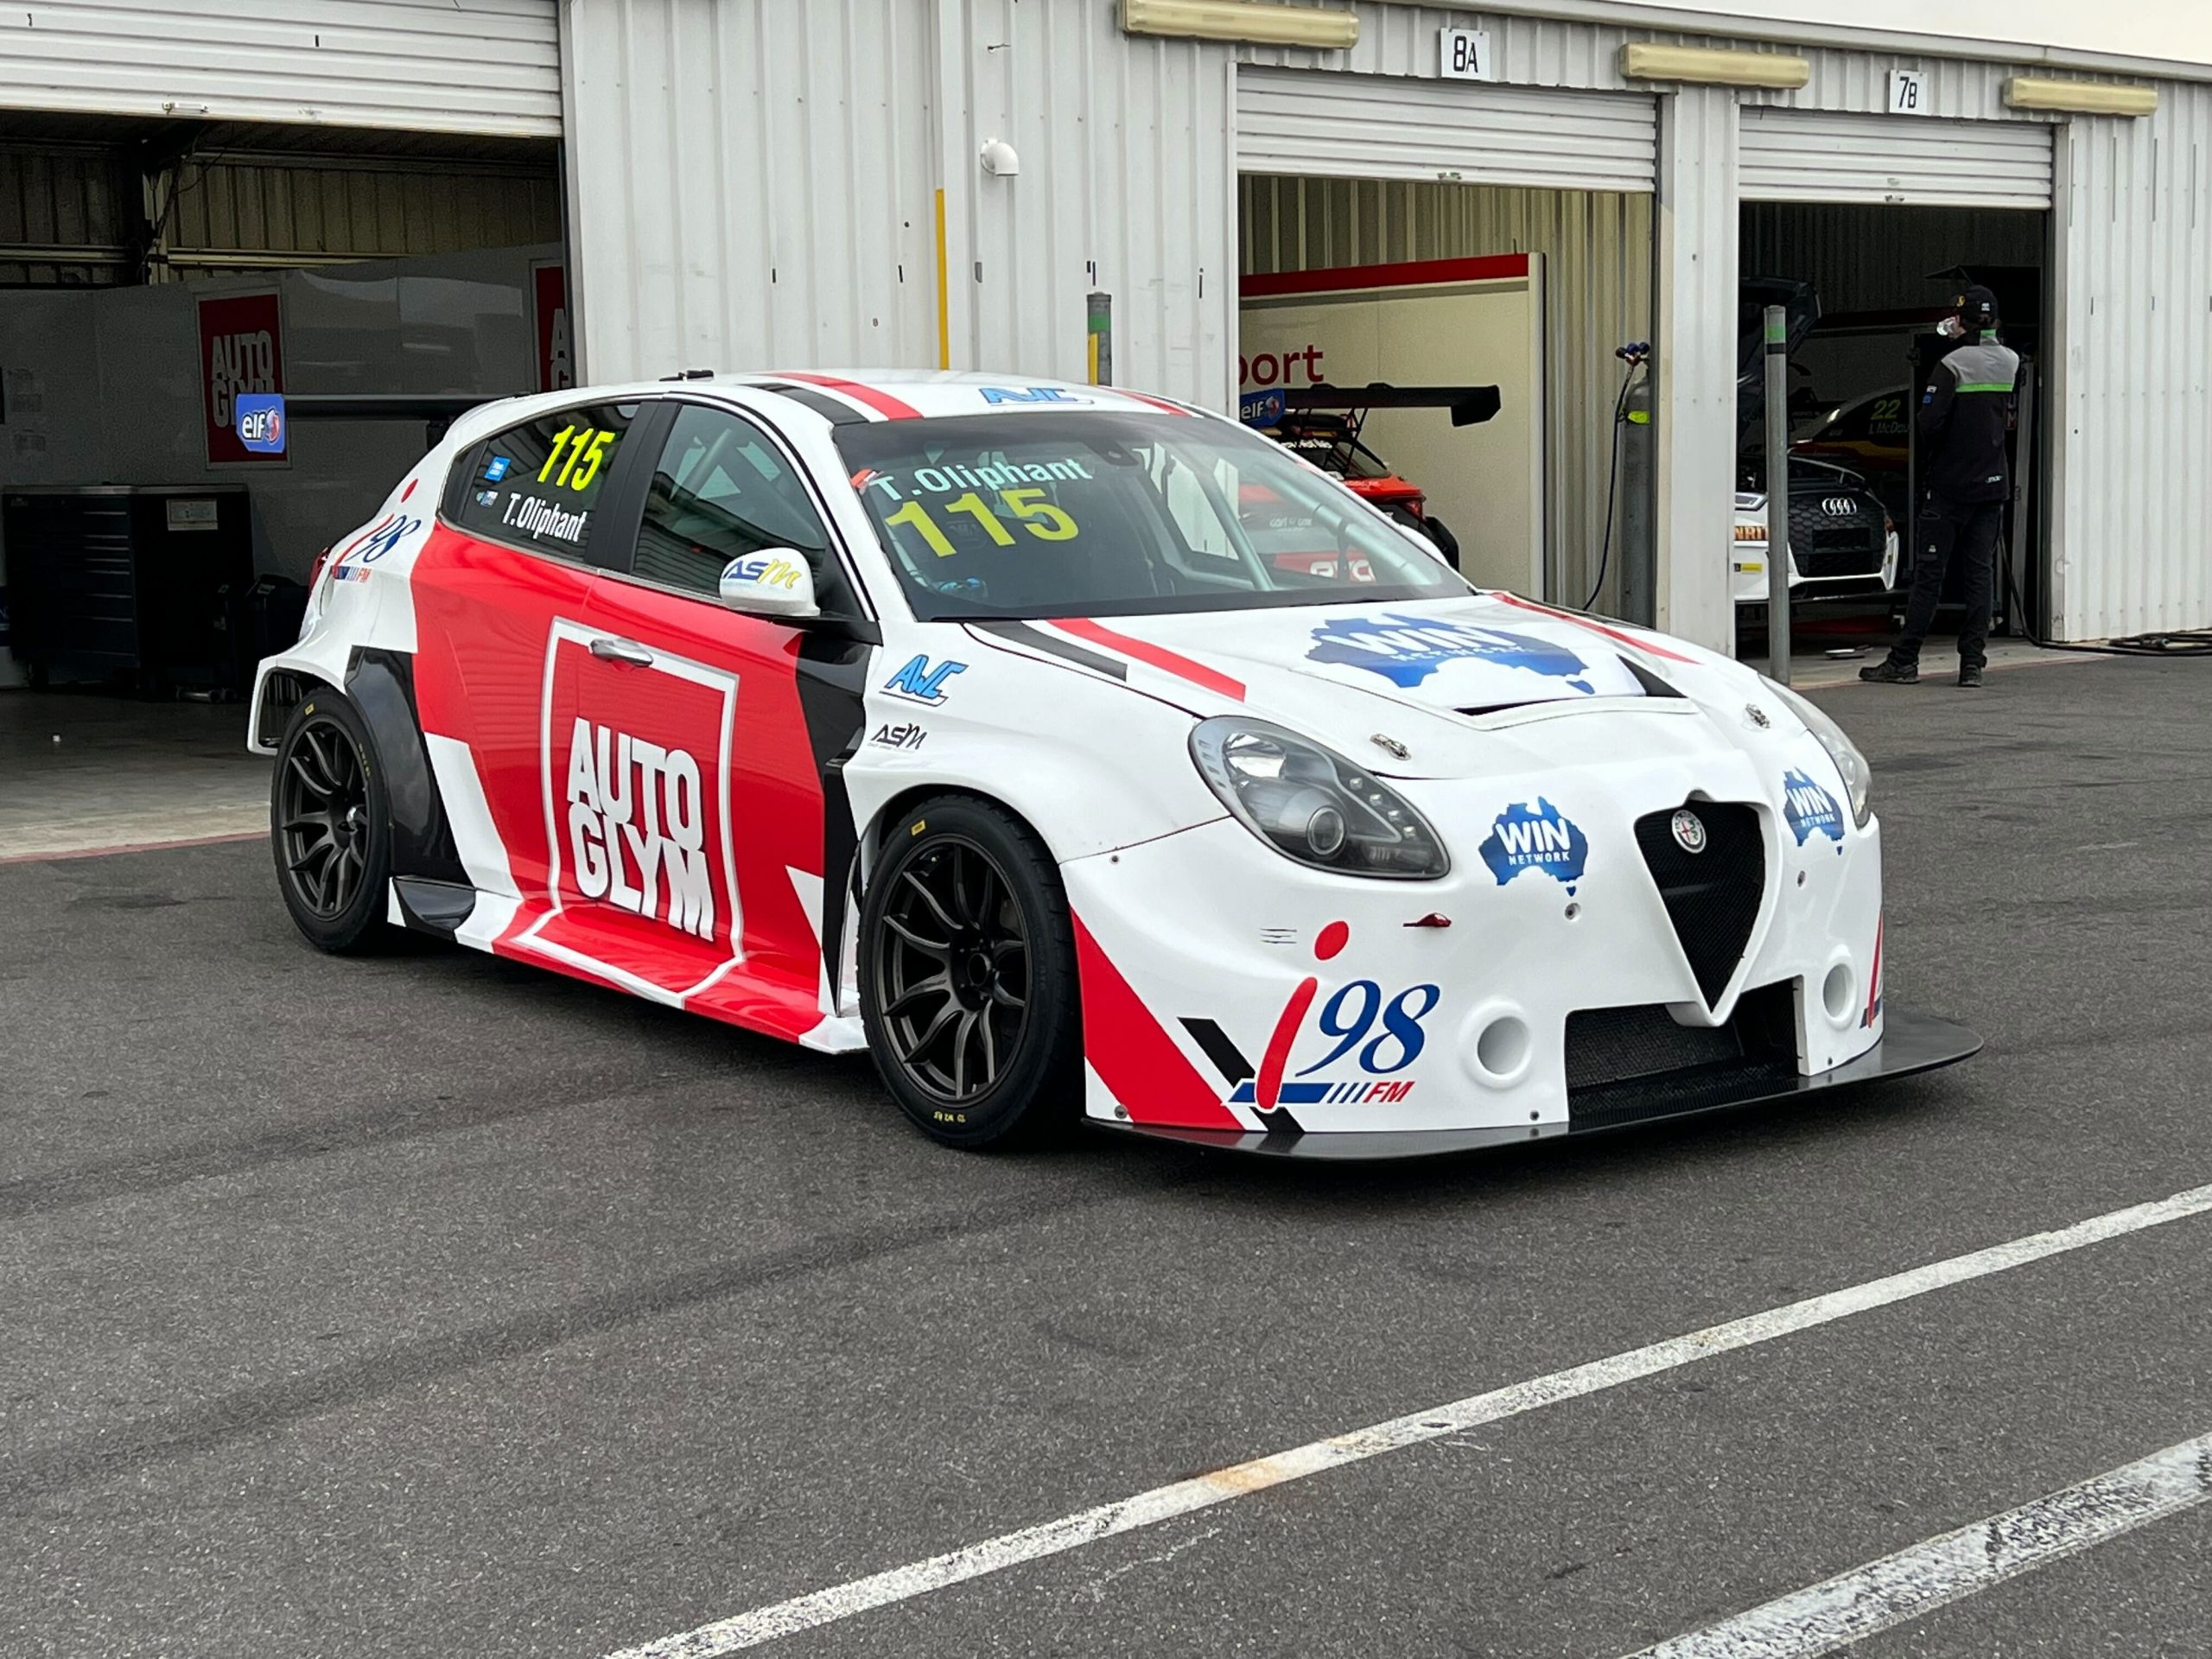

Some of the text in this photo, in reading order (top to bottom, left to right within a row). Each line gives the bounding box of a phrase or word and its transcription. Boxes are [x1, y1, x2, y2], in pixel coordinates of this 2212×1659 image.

[1453, 35, 1478, 73] 8A
[1898, 76, 1917, 109] 7B
[212, 330, 274, 381] AUTO
[242, 414, 265, 439] elf
[1241, 401, 1264, 420] elf
[1871, 399, 1902, 421] 22
[537, 424, 615, 492] 115
[868, 458, 1094, 502] T.Oliphant
[502, 493, 588, 543] T.Oliphant
[885, 487, 1079, 558] 115
[1319, 626, 1517, 656] WIN
[870, 722, 927, 750] ASM
[567, 716, 703, 852] AUTO
[1786, 785, 1833, 817] WIN
[1495, 817, 1571, 855] WIN
[568, 802, 716, 942] GLYM
[1508, 851, 1570, 866] NETWORK
[1256, 921, 1440, 1109] i98
[1363, 1081, 1415, 1103] FM
